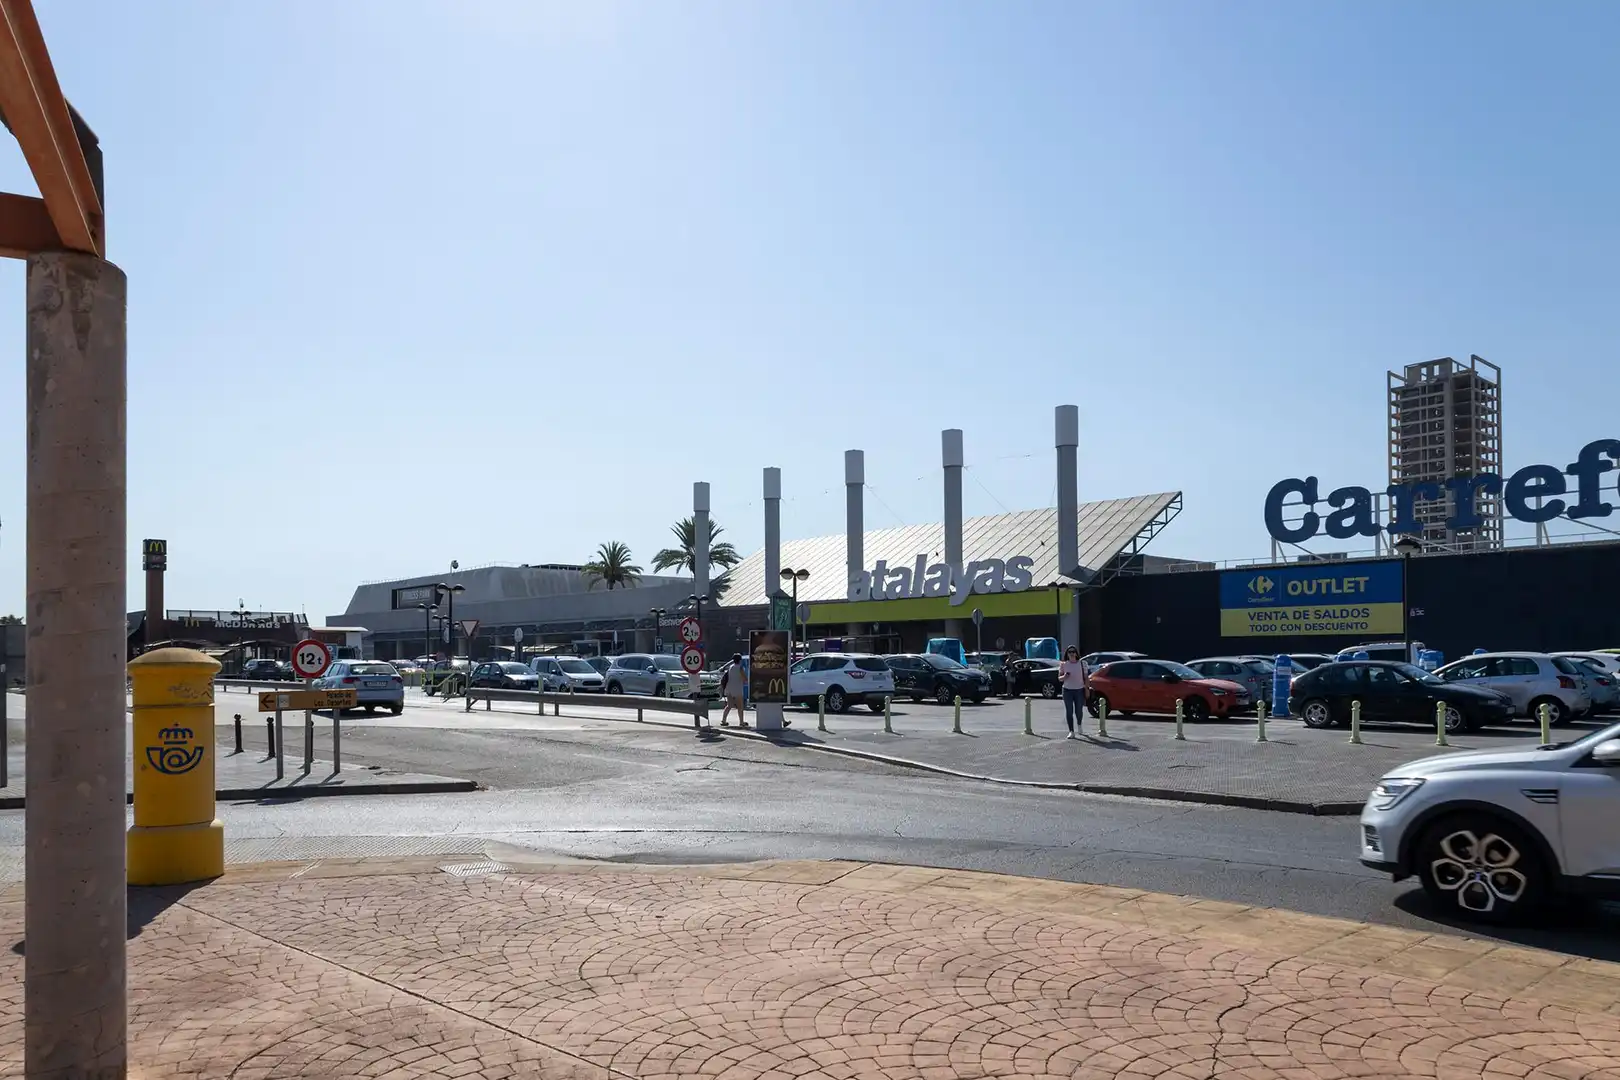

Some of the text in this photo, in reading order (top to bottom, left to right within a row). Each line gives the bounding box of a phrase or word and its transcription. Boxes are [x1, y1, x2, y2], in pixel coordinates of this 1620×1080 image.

[1265, 438, 1620, 544] Carref
[847, 554, 1034, 607] atalayas
[1288, 577, 1369, 596] OUTLET
[1248, 608, 1370, 622] VENTA DE SALDOS
[1249, 622, 1368, 633] TODO CON DESCUENTO
[299, 653, 322, 665] 12 t
[686, 655, 700, 665] 20
